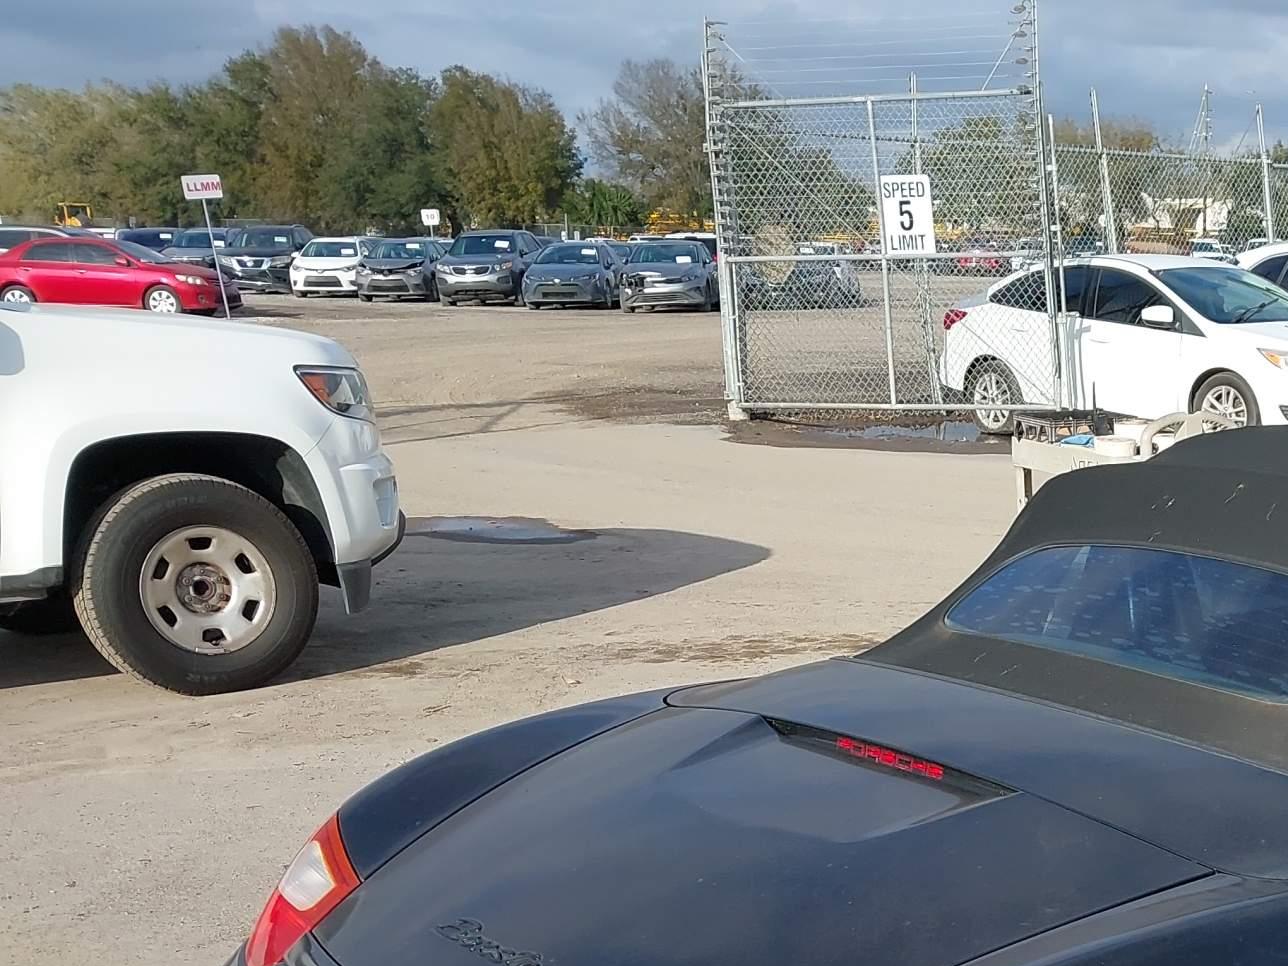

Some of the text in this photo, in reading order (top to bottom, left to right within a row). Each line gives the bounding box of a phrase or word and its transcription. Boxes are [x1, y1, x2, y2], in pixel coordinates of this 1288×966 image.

[186, 181, 224, 192] LLMM
[882, 181, 926, 199] SPEED
[898, 200, 914, 231] 5
[890, 233, 926, 251] LIMIT
[836, 736, 945, 780] PORSCHE
